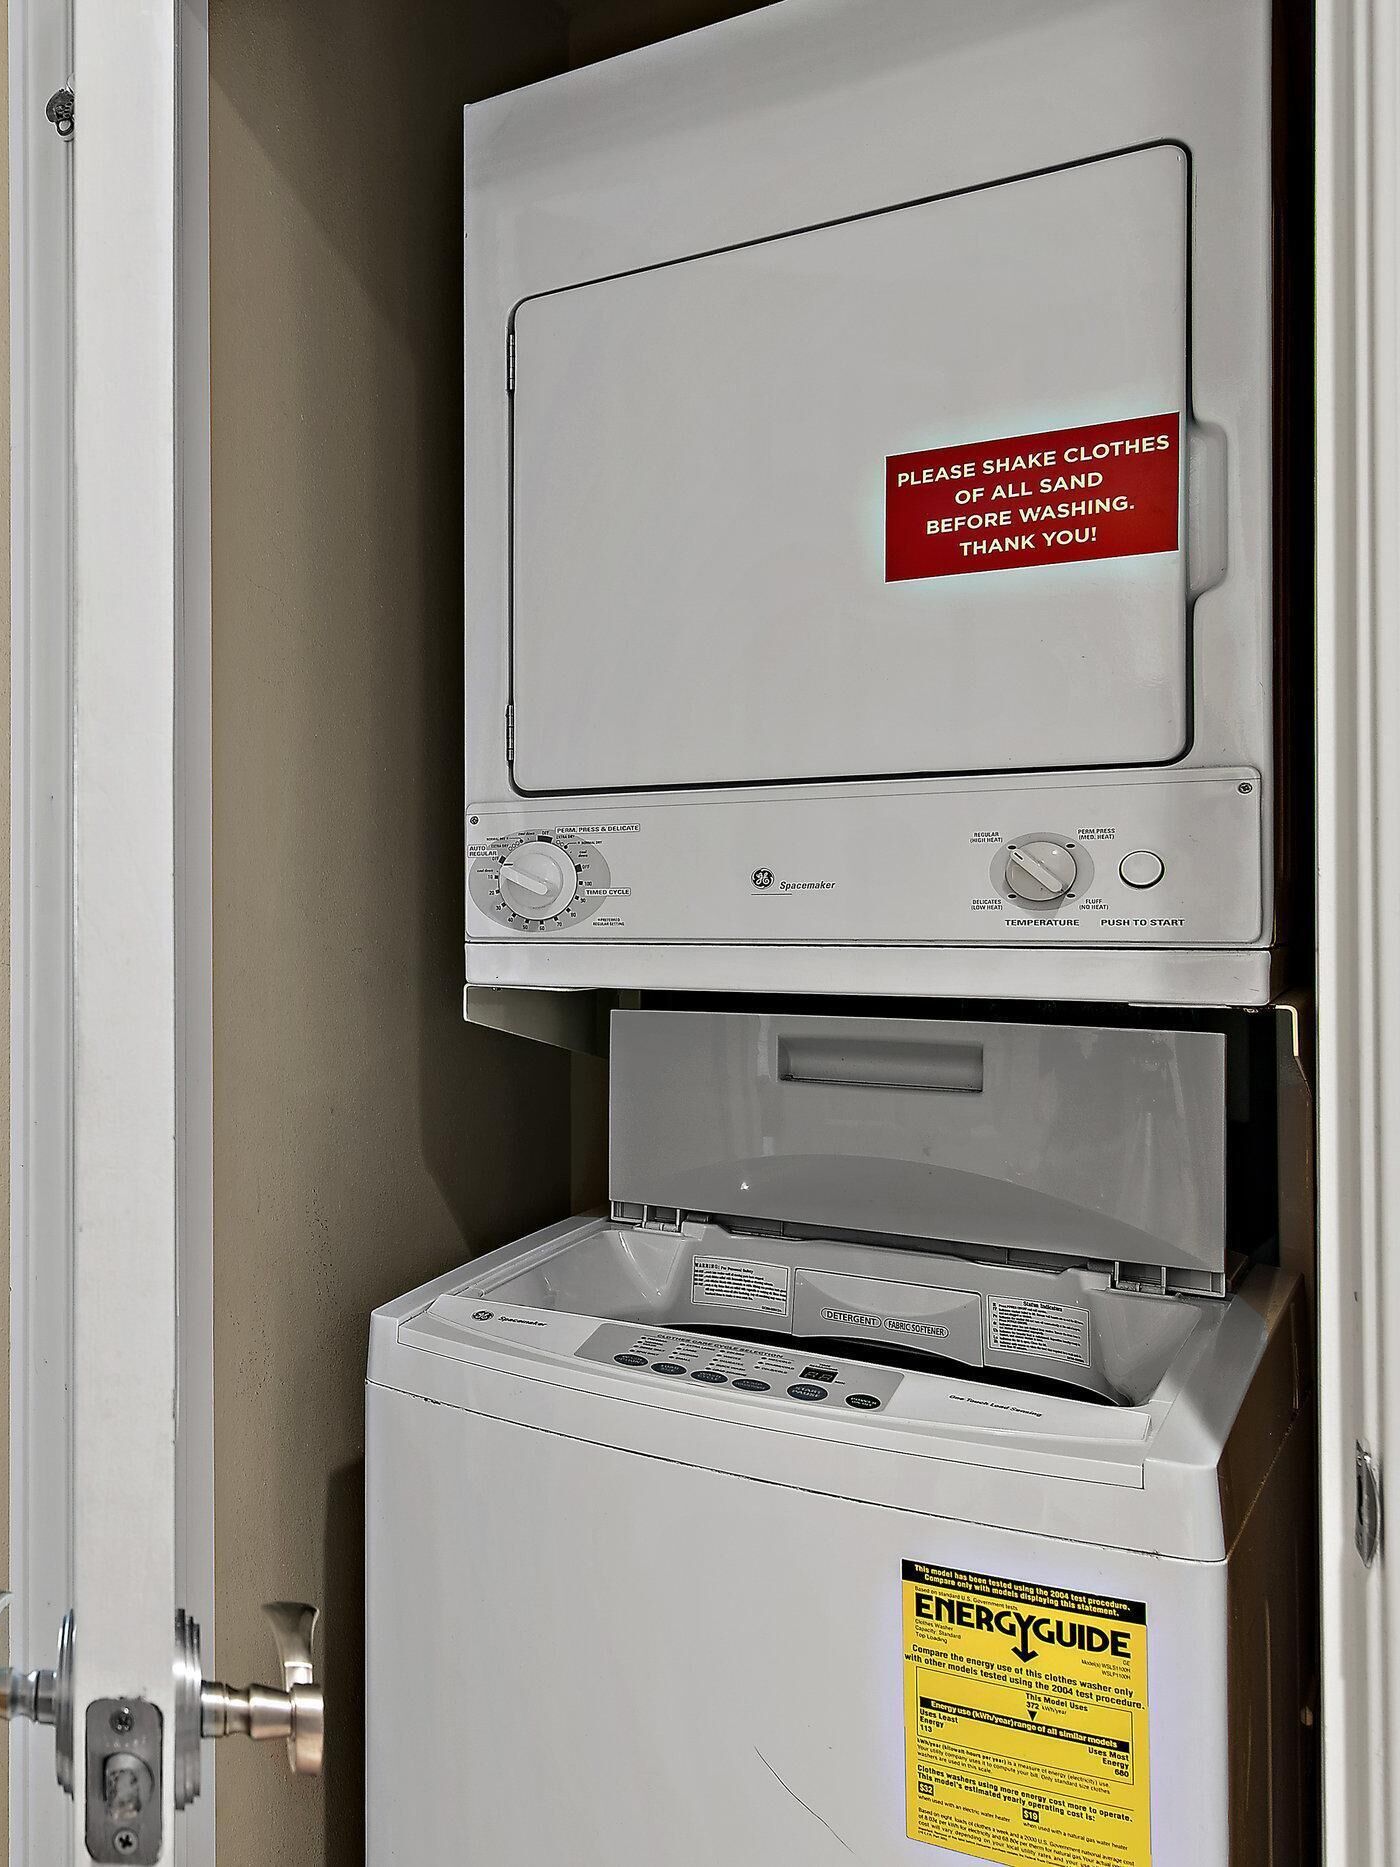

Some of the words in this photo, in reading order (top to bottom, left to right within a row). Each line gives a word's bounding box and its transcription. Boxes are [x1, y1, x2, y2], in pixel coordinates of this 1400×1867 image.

[897, 464, 975, 487] PLEASE
[982, 451, 1056, 474] SHAKE
[1063, 435, 1169, 463] CLOTHES
[954, 488, 984, 505] OF
[991, 481, 1033, 501] ALL
[1039, 472, 1103, 494] SAND
[926, 511, 1012, 535] BEFORE
[1019, 496, 1135, 523] WASHING.
[959, 534, 1035, 556] THANK
[1042, 527, 1097, 547] YOU!
[780, 881, 835, 891] Spacemaker
[827, 1310, 877, 1326] DETERGENT
[888, 1320, 910, 1331] FABRIC
[911, 1322, 945, 1336] SOFTENER
[915, 1565, 929, 1573] This
[931, 1568, 952, 1577] model
[955, 1572, 967, 1580] has
[969, 1575, 986, 1584] been
[988, 1579, 1011, 1588] tested
[1014, 1583, 1033, 1593] using
[1050, 1590, 1069, 1599] 2004
[1071, 1594, 1086, 1602] test
[1088, 1597, 1130, 1611] procedure.
[924, 1574, 955, 1586] Compare
[957, 1580, 972, 1590] only
[974, 1584, 990, 1592] with
[992, 1587, 1018, 1597] models
[1020, 1592, 1058, 1606] displaying
[1060, 1600, 1075, 1608] this
[1077, 1603, 1119, 1616] statement.
[915, 1592, 1131, 1659] ENERGYGUIDE
[927, 1634, 947, 1643] Loading
[912, 1644, 948, 1659] Compare
[950, 1653, 963, 1662] the
[966, 1656, 994, 1669] energy
[997, 1663, 1011, 1672] use
[1014, 1666, 1022, 1674] of
[1026, 1669, 1042, 1678] this
[1044, 1672, 1077, 1686] clothes
[1079, 1679, 1111, 1692] washer
[1114, 1686, 1133, 1698] only
[904, 1652, 921, 1662] with
[924, 1657, 945, 1668] other
[948, 1662, 977, 1675] models
[980, 1670, 1006, 1681] tested
[1009, 1676, 1032, 1687] using
[1035, 1681, 1049, 1690] the
[1051, 1684, 1073, 1695] 2004
[1076, 1689, 1093, 1699] test
[1095, 1693, 1145, 1711] procedure.
[1025, 1693, 1041, 1701] This
[1043, 1697, 1067, 1707] Model
[1069, 1702, 1088, 1711] Uses
[1026, 1701, 1039, 1709] 372
[919, 1708, 936, 1718] Uses
[938, 1713, 958, 1723] Least
[919, 1715, 943, 1728] Energy
[920, 1724, 932, 1732] 113
[931, 1701, 956, 1713] Energy
[958, 1707, 971, 1715] use
[1037, 1724, 1045, 1732] of
[1059, 1729, 1085, 1741] similar
[1087, 1735, 1117, 1748] models
[1088, 1747, 1107, 1756] Uses
[1109, 1751, 1129, 1761] Most
[1102, 1757, 1129, 1770] Energy
[1114, 1768, 1129, 1777] 680
[917, 1764, 944, 1777] Clothes
[946, 1772, 976, 1784] washers
[978, 1780, 998, 1791] using
[1000, 1785, 1018, 1795] more
[1021, 1791, 1046, 1803] energy
[1048, 1797, 1065, 1806] cost
[1067, 1802, 1086, 1811] more
[1099, 1808, 1132, 1823] operate.
[917, 1772, 932, 1781] This
[934, 1776, 962, 1789] model's
[964, 1784, 1000, 1798] estimated
[1002, 1793, 1025, 1805] yearly
[1027, 1800, 1064, 1814] operating
[1066, 1809, 1083, 1818] cost
[1085, 1813, 1095, 1821] is:
[919, 1783, 932, 1793] $32
[1023, 1810, 1038, 1820] $19
